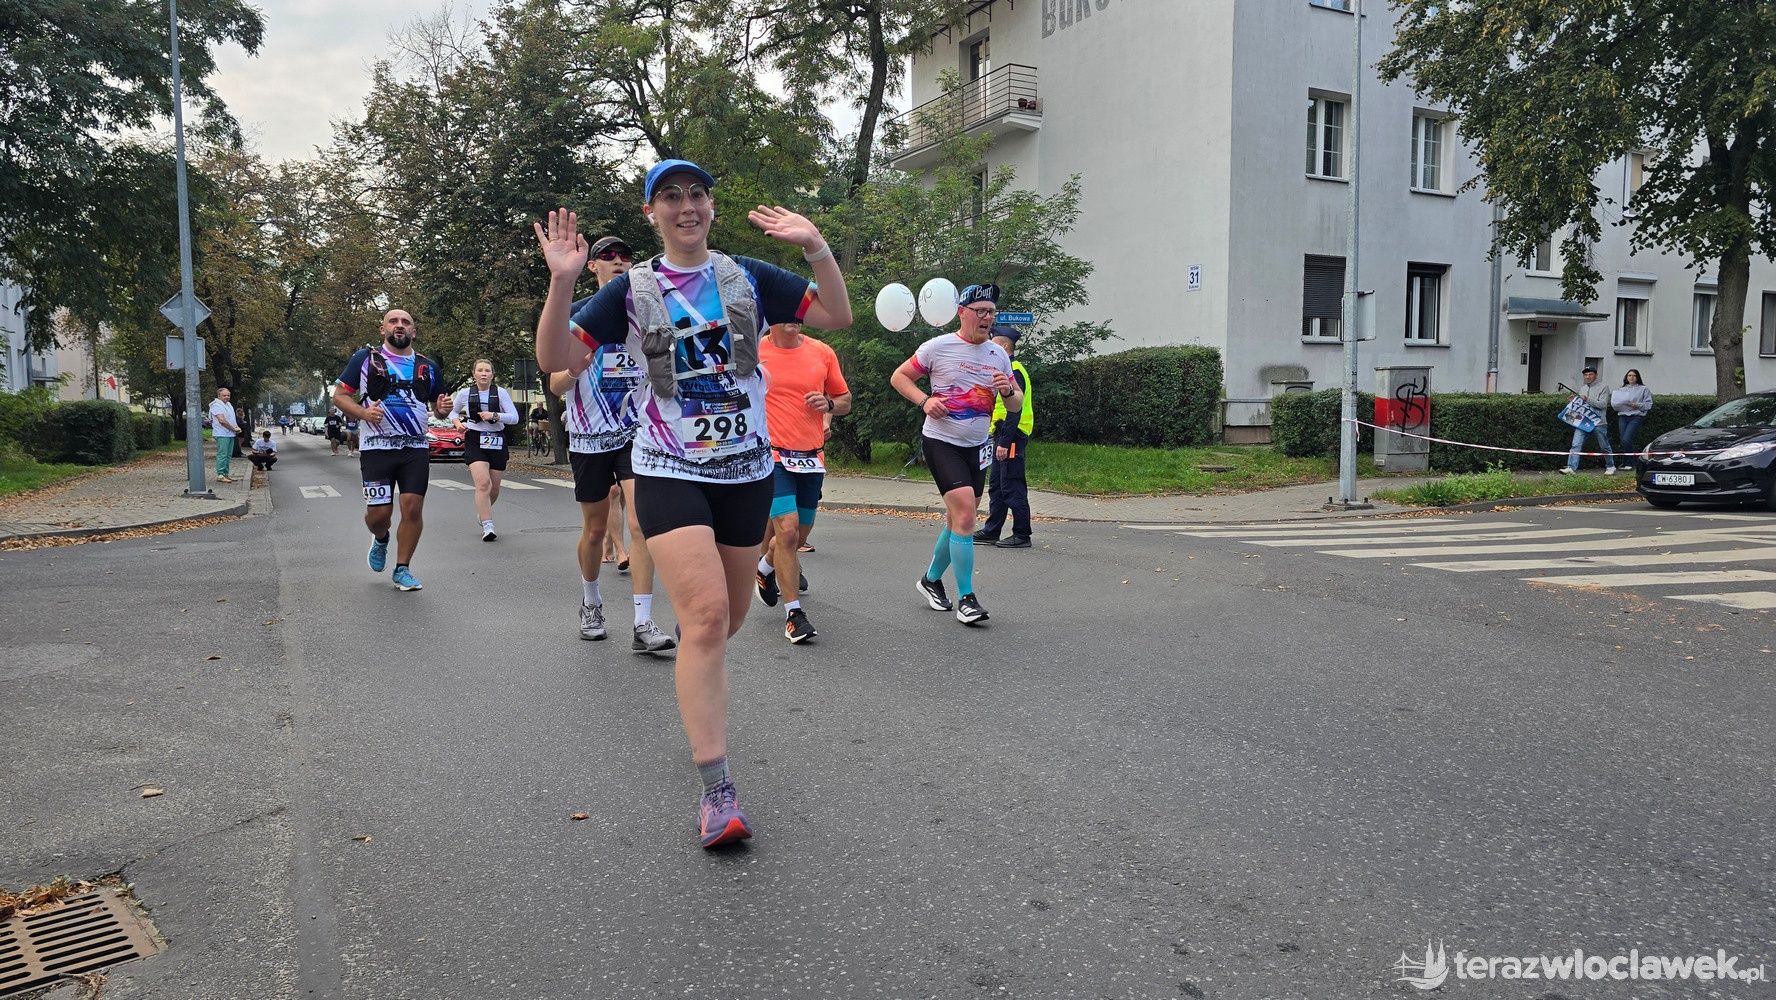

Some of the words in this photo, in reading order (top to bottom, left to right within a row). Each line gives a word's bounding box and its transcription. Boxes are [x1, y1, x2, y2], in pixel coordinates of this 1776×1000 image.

[1189, 271, 1199, 284] 31
[1008, 314, 1031, 322] Bukowa
[694, 413, 748, 442] 298
[484, 436, 499, 446] 271
[787, 458, 816, 468] 640
[1656, 474, 1666, 482] CW
